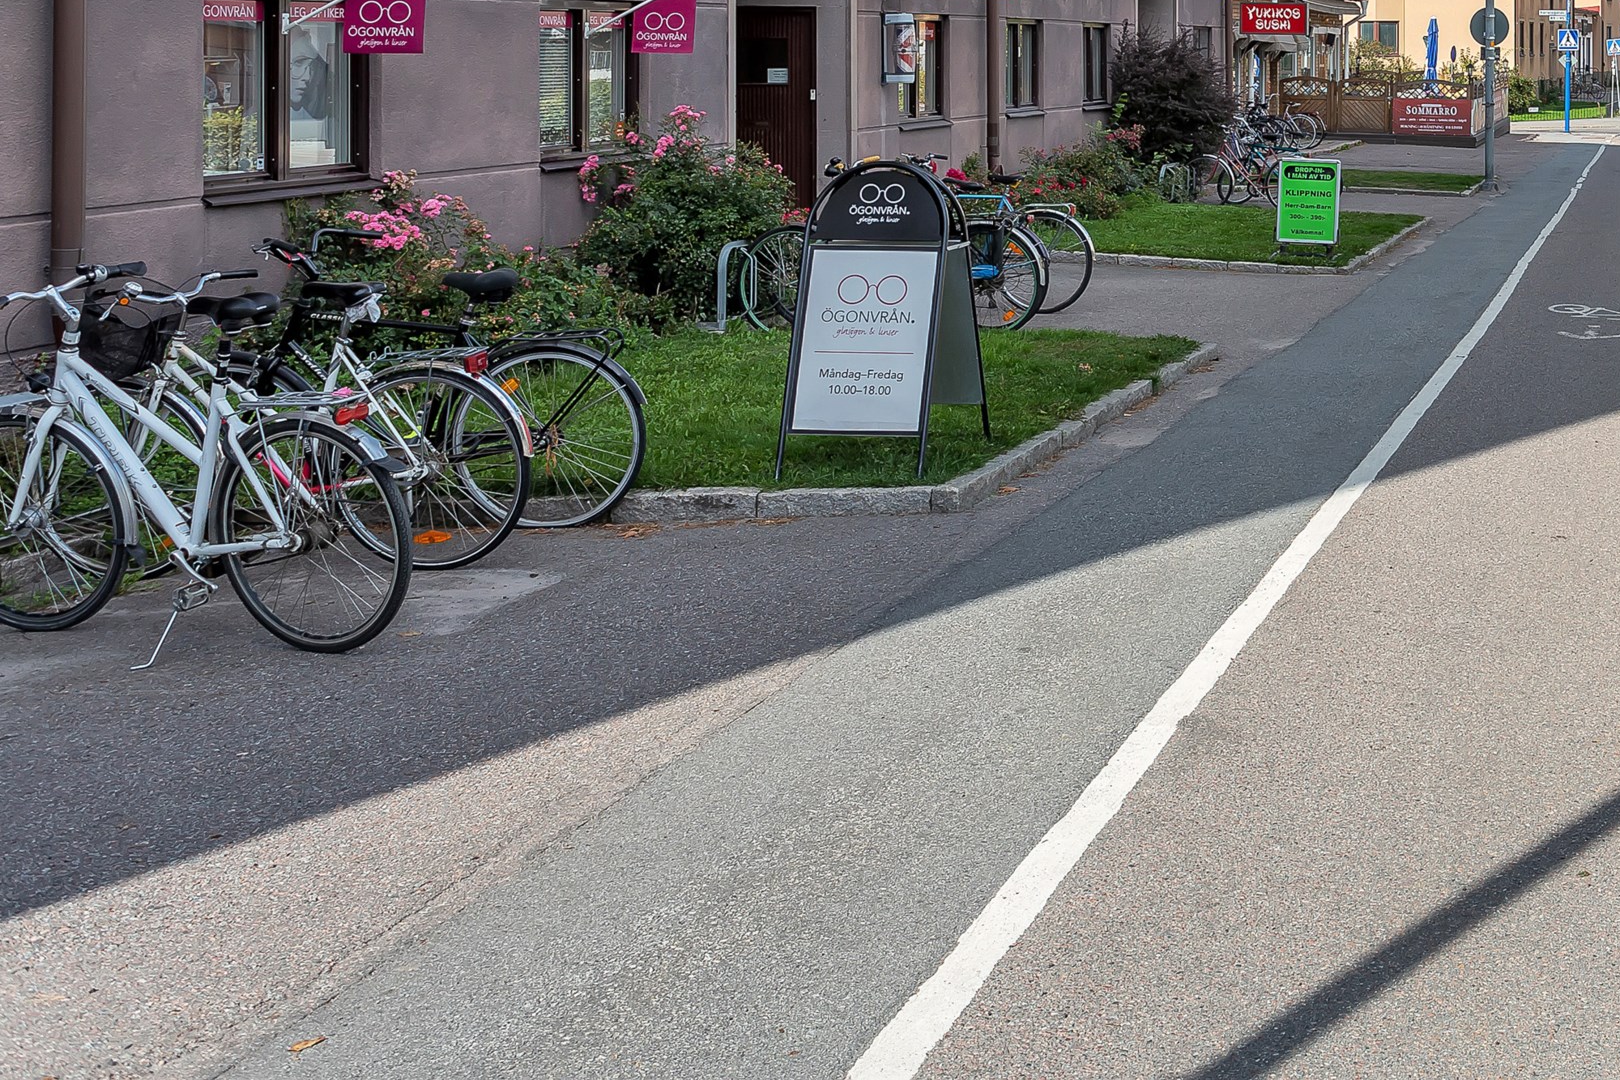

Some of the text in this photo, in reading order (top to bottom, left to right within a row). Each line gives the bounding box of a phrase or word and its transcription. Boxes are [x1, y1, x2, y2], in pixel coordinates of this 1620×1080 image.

[1246, 5, 1301, 20] YUKIKOS
[1255, 18, 1291, 30] SUSHI
[347, 25, 415, 38] ÖGONVRÅN
[636, 31, 688, 41] ÖGONVRÅN
[1405, 105, 1458, 116] SOMMARRO
[1285, 189, 1332, 198] KLIPPNING
[849, 204, 911, 215] ÖGONVRÅN.
[821, 307, 916, 324] ÖGONVRÅN.
[832, 325, 900, 339] glasögon & linser
